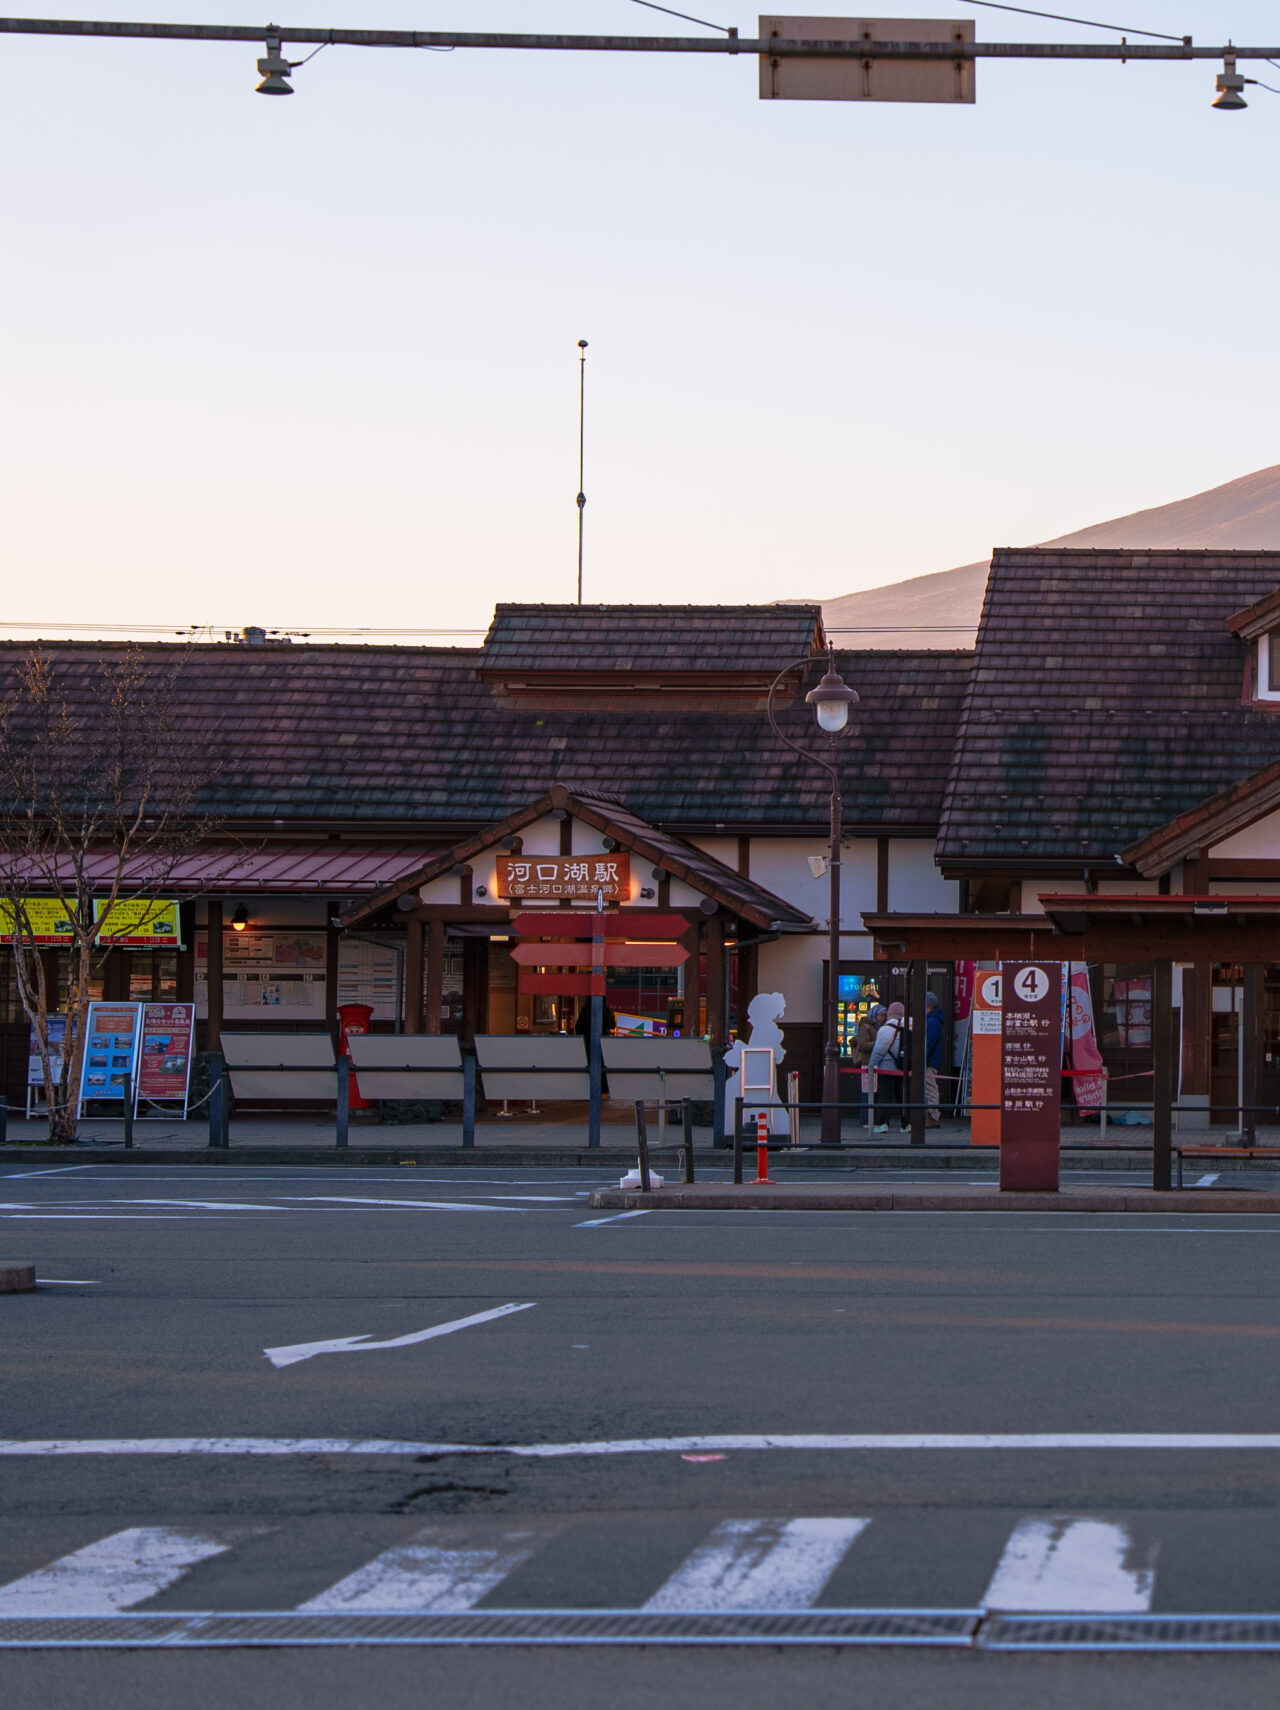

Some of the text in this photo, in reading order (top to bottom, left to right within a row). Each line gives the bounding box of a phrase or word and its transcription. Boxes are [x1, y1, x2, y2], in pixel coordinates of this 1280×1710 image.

[507, 862, 619, 881] 河口湖駅
[991, 980, 999, 998] 1
[1022, 969, 1038, 993] 4
